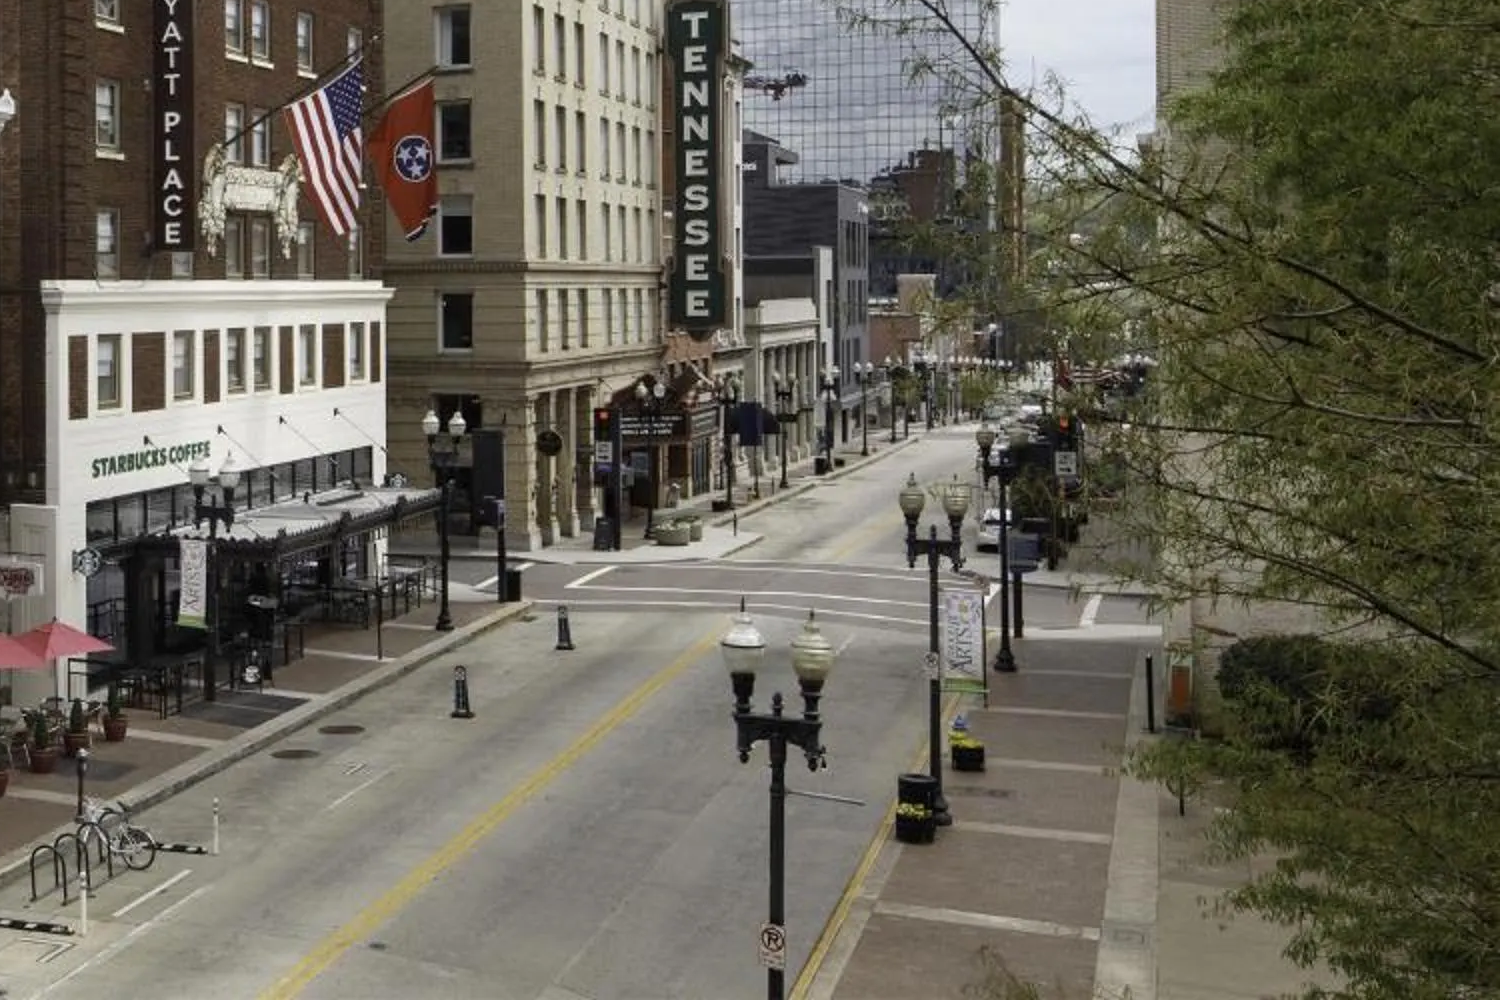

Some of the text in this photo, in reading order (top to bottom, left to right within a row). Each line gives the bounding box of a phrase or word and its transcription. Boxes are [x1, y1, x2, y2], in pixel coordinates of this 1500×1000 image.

[164, 111, 183, 244] PLACE
[681, 11, 709, 317] TENNESSEE
[92, 440, 210, 478] STARBUCKS COFFEE
